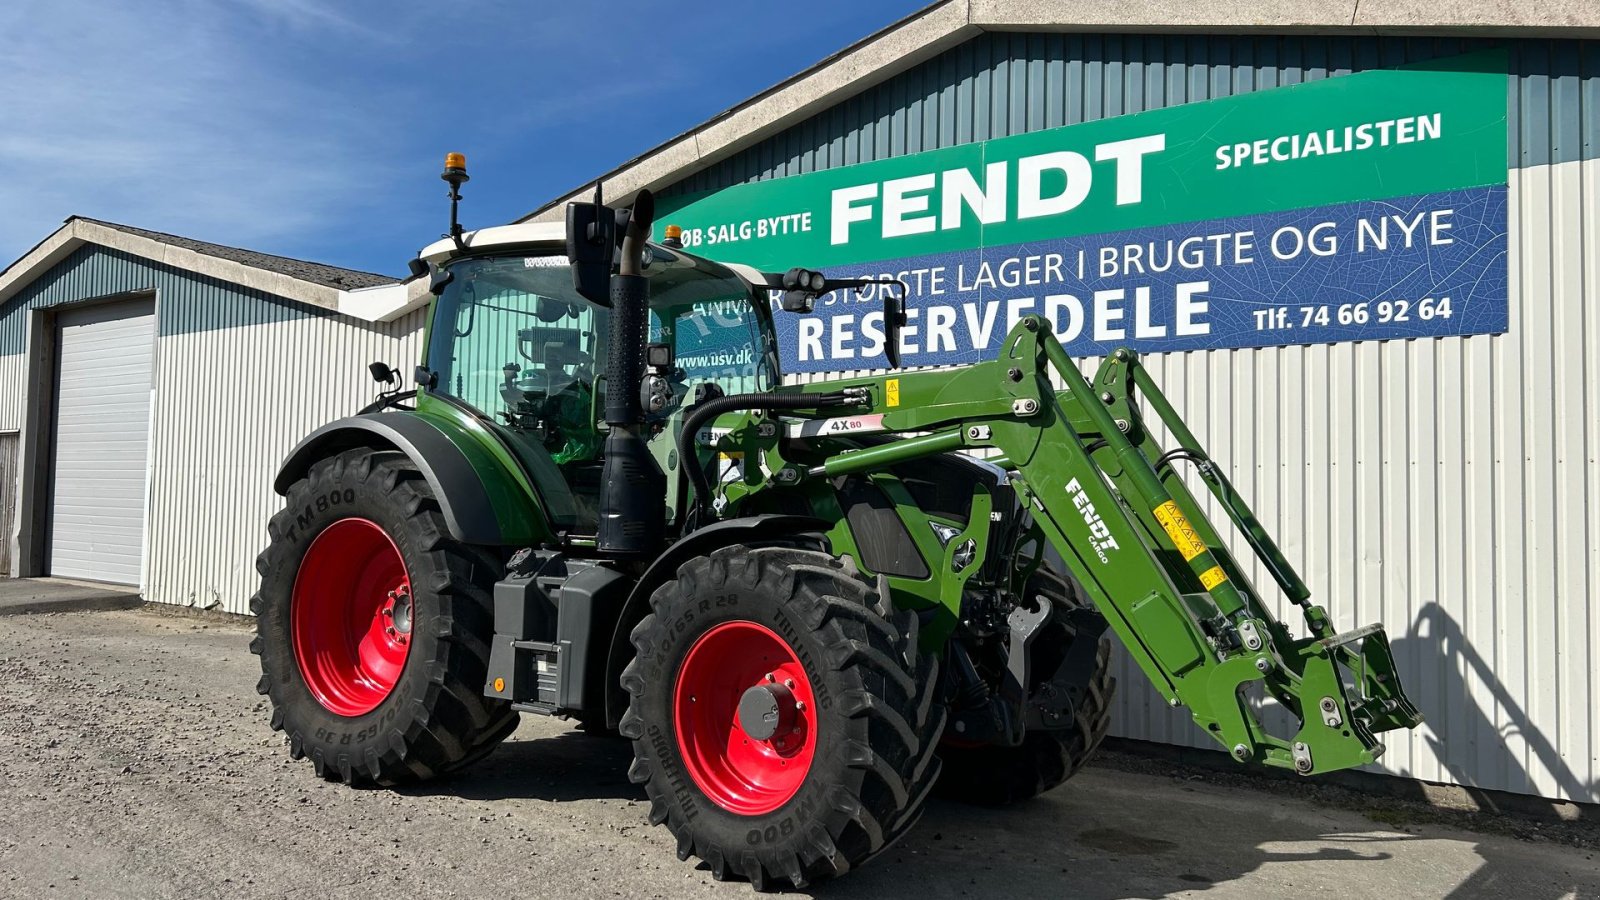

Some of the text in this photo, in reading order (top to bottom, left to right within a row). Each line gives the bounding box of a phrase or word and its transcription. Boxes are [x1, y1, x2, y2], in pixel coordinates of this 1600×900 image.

[1215, 112, 1441, 171] SPECIALISTEN
[830, 133, 1166, 246] FENDT
[680, 211, 812, 248] ØB·SALG·BYTTE
[957, 253, 1065, 293] LAGER
[1078, 250, 1084, 280] I
[1099, 231, 1255, 279] BRUGTE
[1270, 222, 1337, 261] OG
[1358, 209, 1455, 254] NYE
[1253, 297, 1453, 331] Tlf. 74 66 92 64
[674, 349, 753, 369] www.usv.dk
[701, 432, 726, 441] FEN
[315, 488, 355, 514] 800
[1064, 477, 1120, 551] FENDT
[1088, 535, 1109, 564] CARGO
